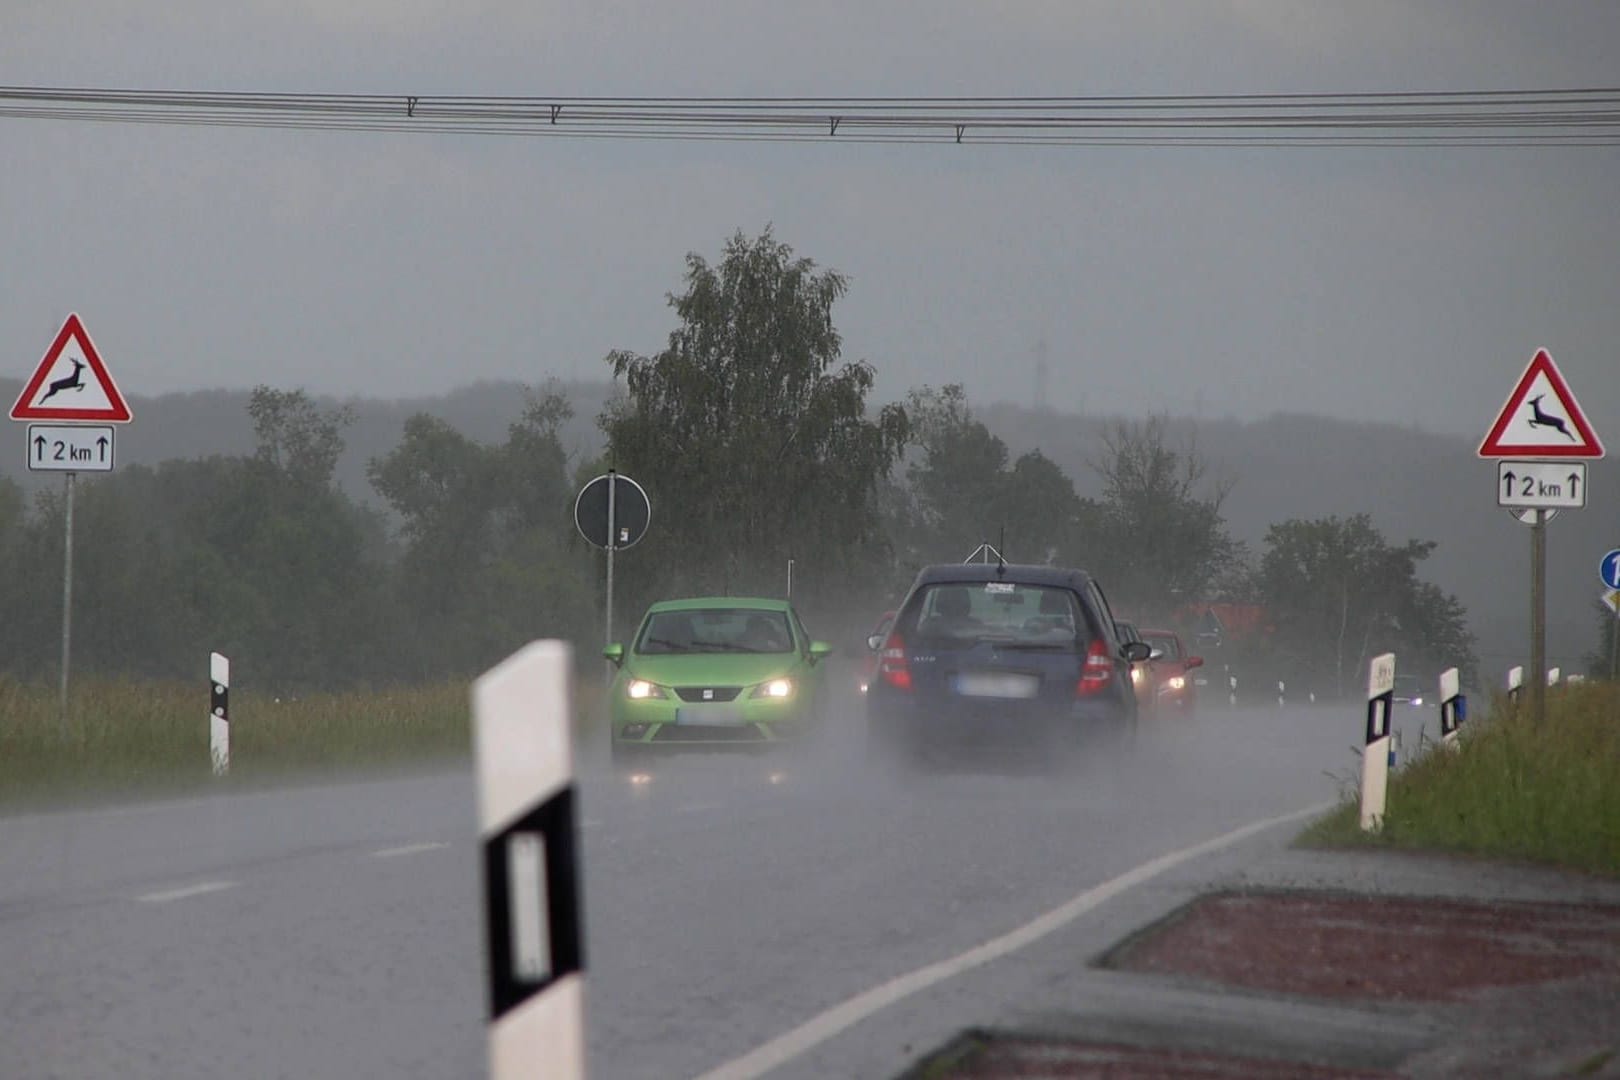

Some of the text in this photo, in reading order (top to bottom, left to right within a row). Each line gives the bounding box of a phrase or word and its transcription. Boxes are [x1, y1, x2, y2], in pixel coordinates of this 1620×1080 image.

[53, 440, 92, 461] 2 km
[1522, 476, 1562, 497] 2 km
